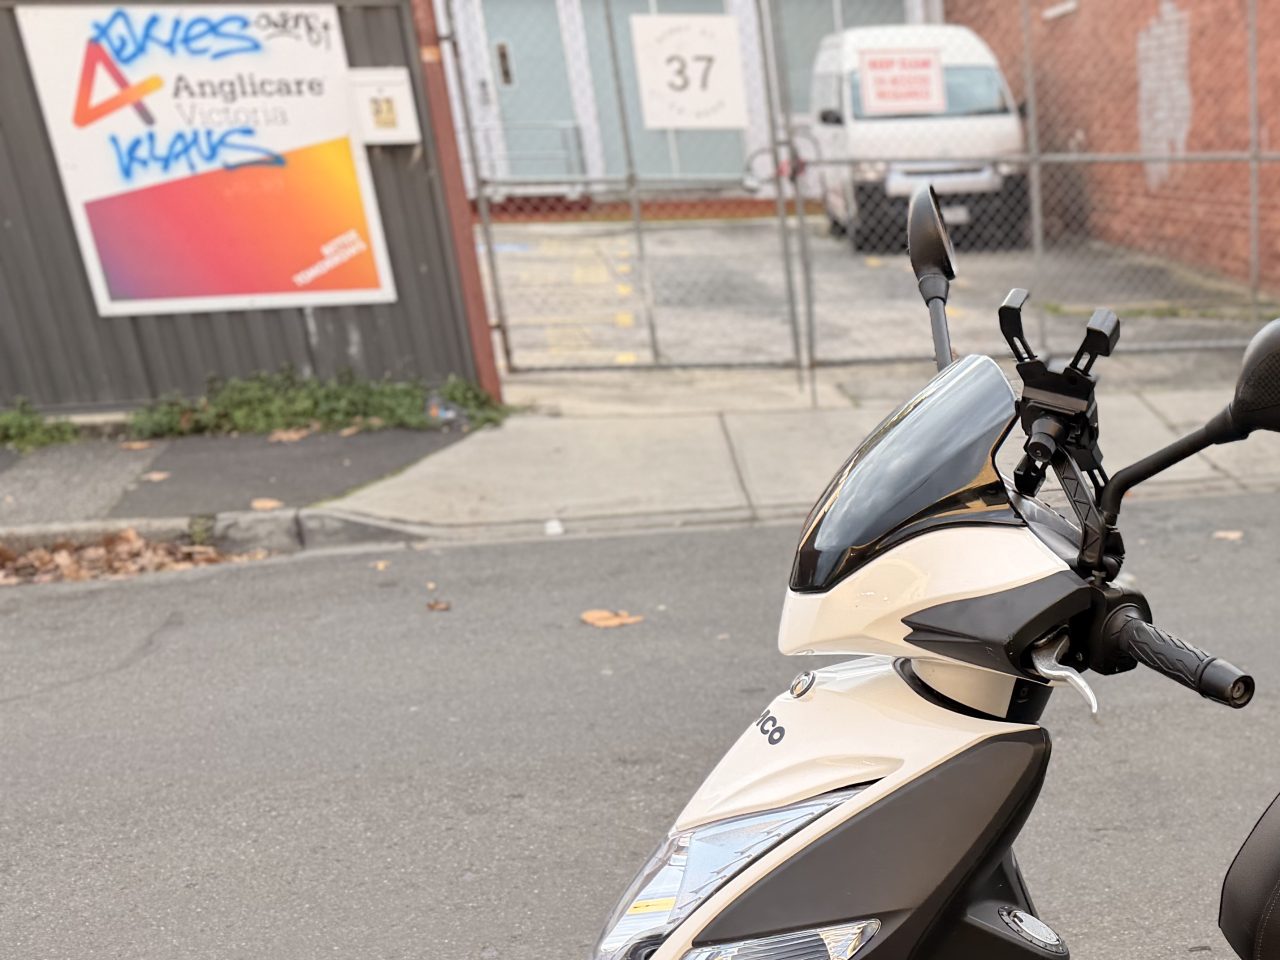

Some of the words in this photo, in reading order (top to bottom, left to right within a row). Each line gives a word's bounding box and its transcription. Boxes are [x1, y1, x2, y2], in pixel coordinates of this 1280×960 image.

[664, 54, 716, 92] 37
[172, 74, 325, 102] Anglicare
[175, 102, 289, 127] Victoria
